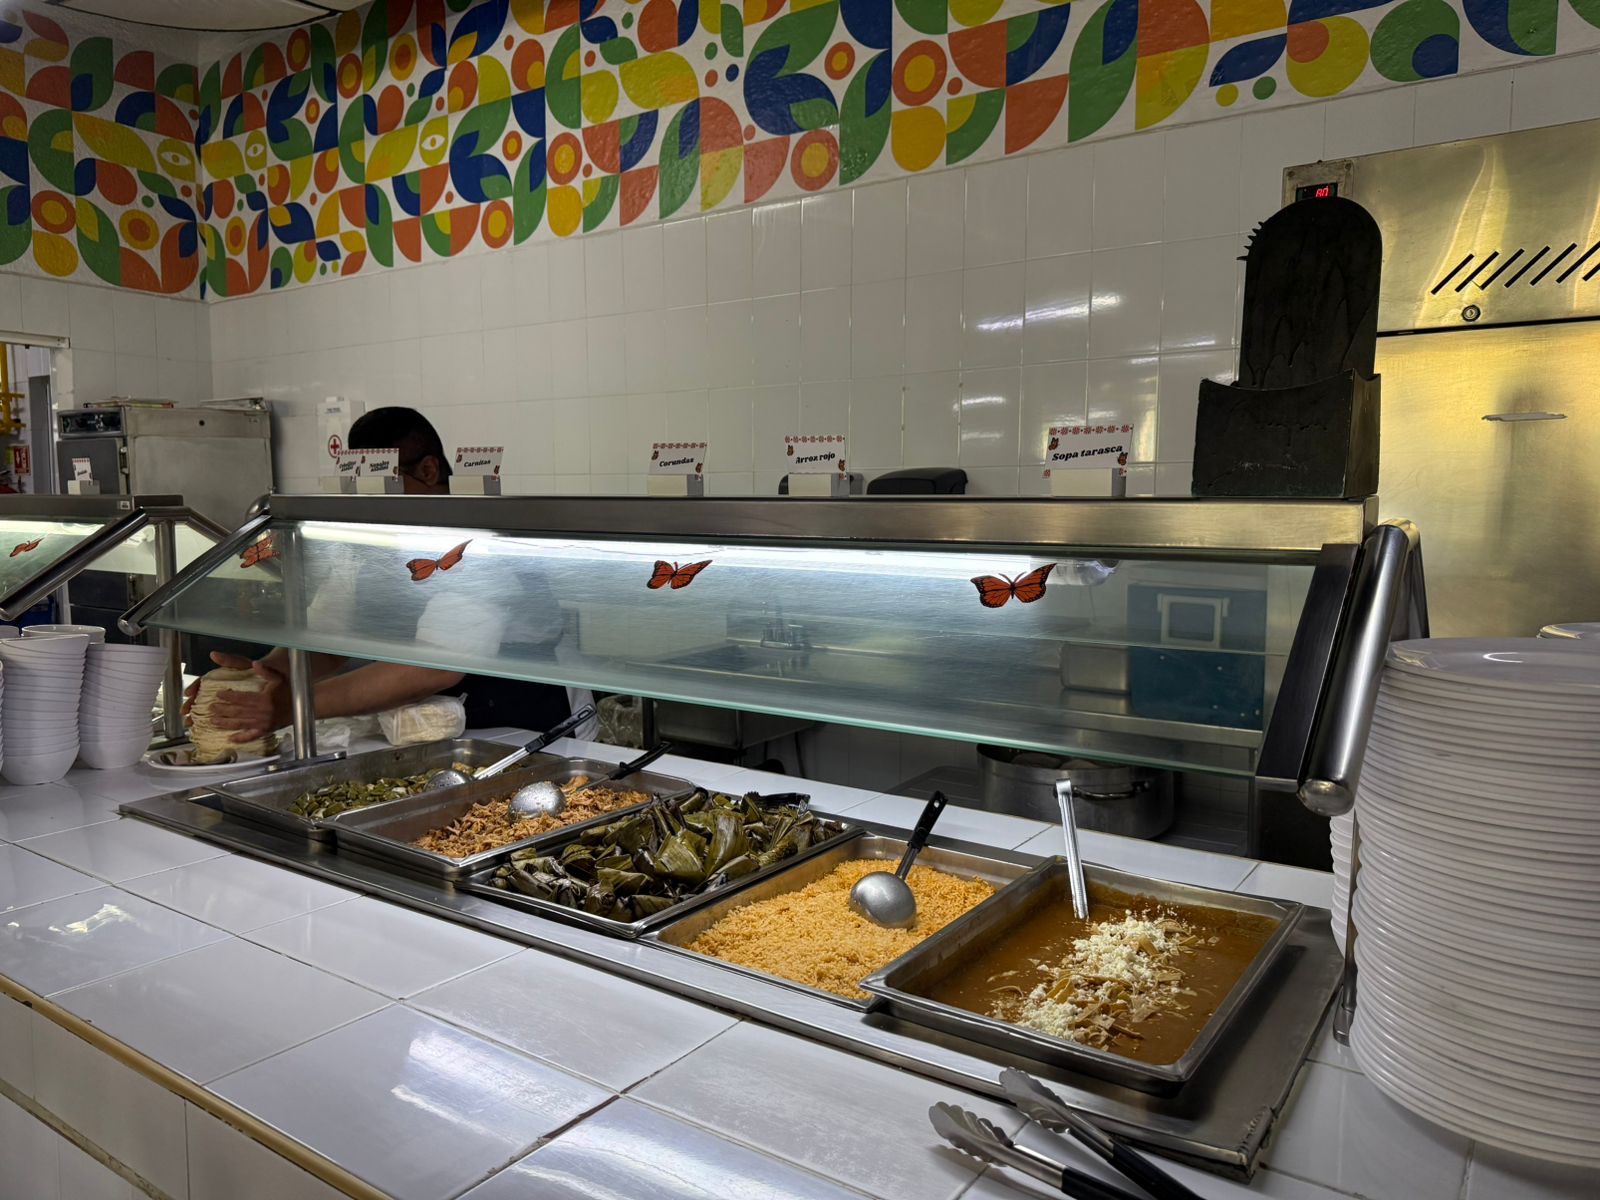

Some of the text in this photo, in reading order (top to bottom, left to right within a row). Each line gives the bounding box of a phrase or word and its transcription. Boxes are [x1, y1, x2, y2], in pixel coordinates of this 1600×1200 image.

[820, 452, 836, 461] rojo
[1052, 445, 1123, 461] Sopa tarasca
[659, 457, 694, 467] Corundas
